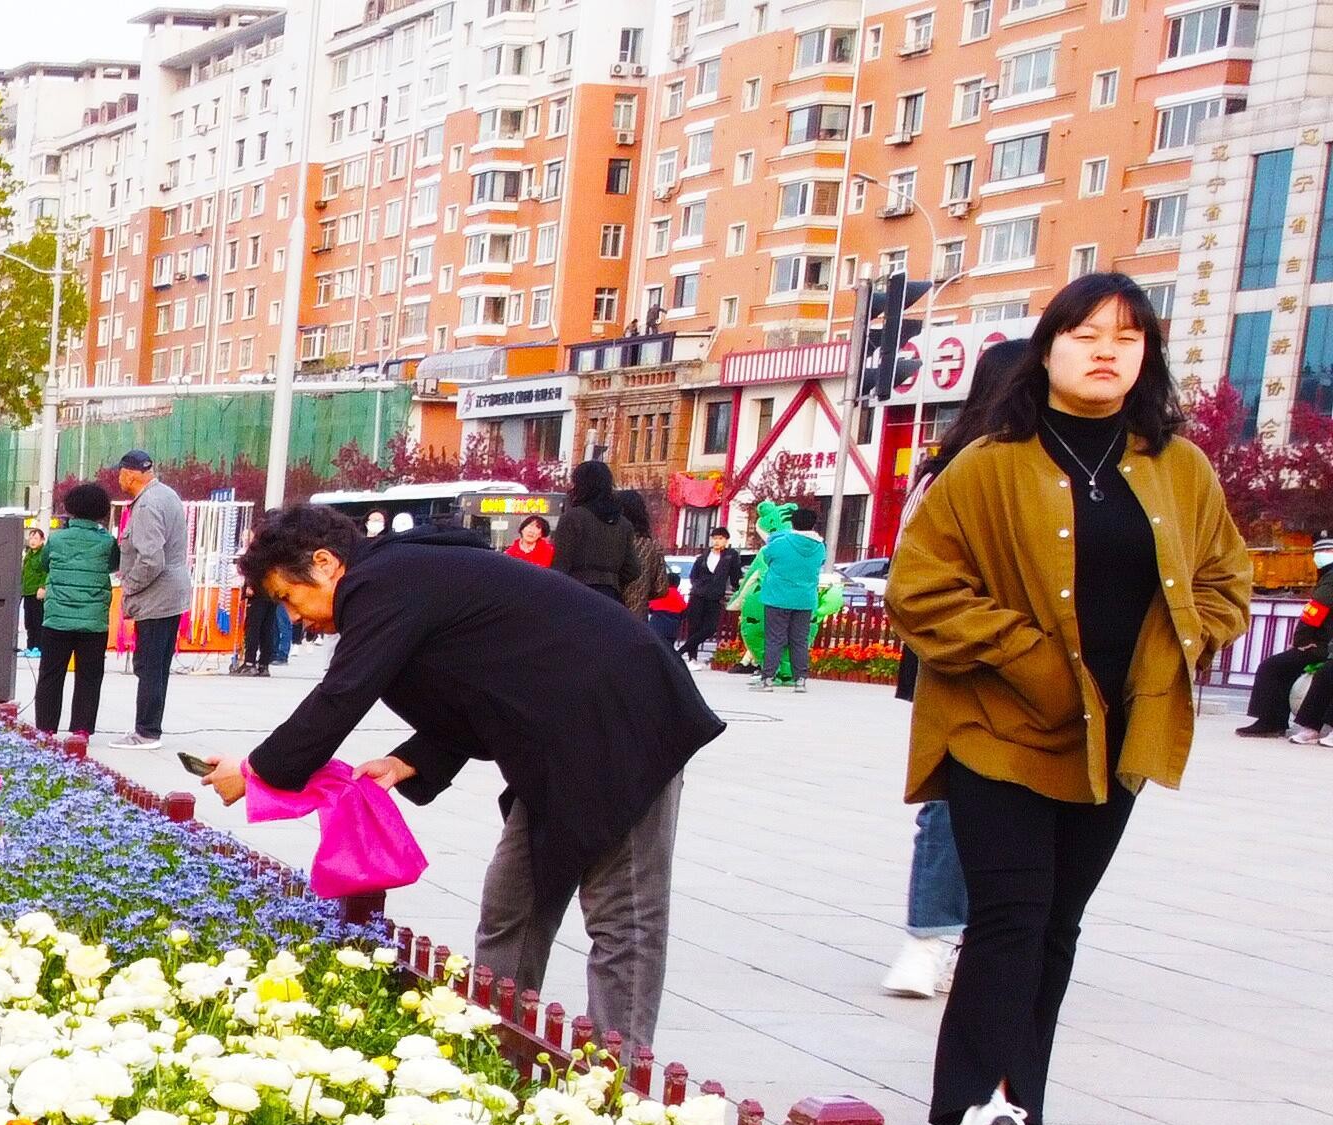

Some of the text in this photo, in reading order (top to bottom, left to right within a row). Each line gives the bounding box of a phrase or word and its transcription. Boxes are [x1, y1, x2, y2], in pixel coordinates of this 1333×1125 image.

[1260, 127, 1321, 439] 辽宁省自驾游协会
